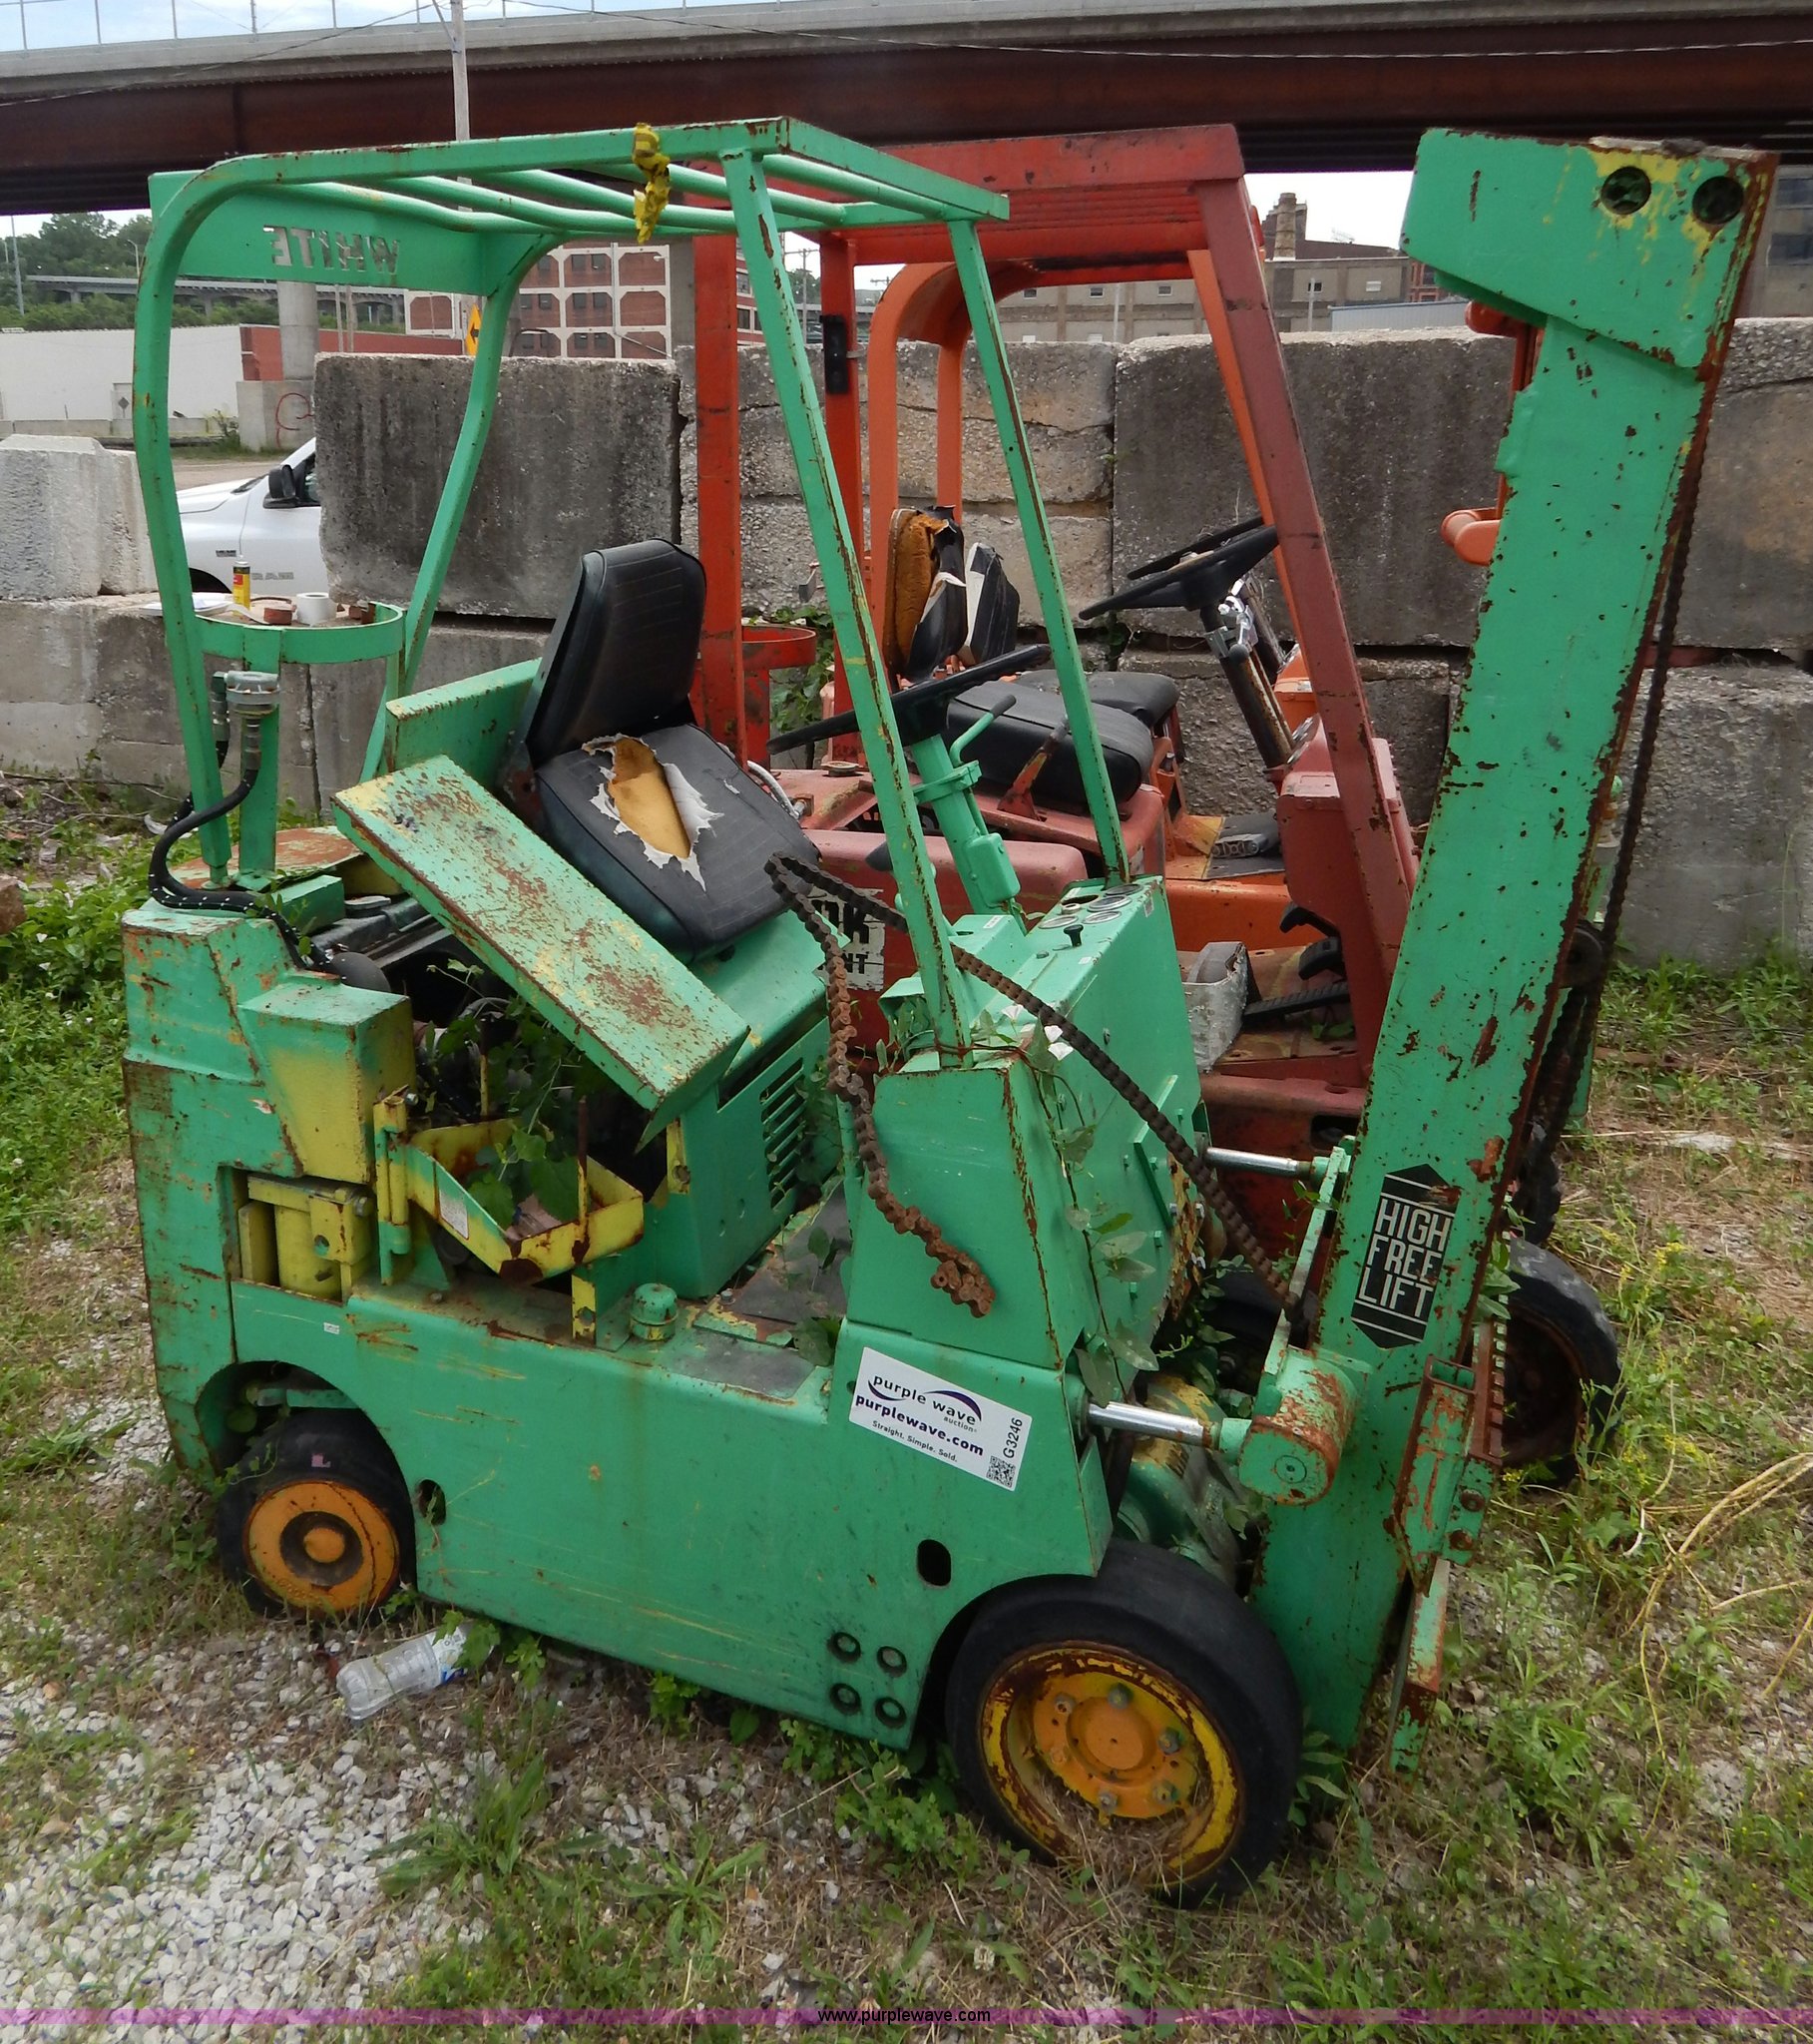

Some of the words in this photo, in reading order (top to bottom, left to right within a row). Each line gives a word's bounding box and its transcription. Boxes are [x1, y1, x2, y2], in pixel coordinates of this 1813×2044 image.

[1375, 1198, 1452, 1252] HIGH
[1366, 1233, 1443, 1286] FREE
[1358, 1267, 1435, 1318] LIFT
[855, 1394, 985, 1456] purplewave.com
[872, 1374, 927, 1405] purple
[932, 1398, 977, 1426] wave
[872, 1419, 905, 1440] Straight.
[907, 1435, 936, 1453] Simple.
[938, 1448, 958, 1462] Sold.
[1003, 1417, 1024, 1459] G3246
